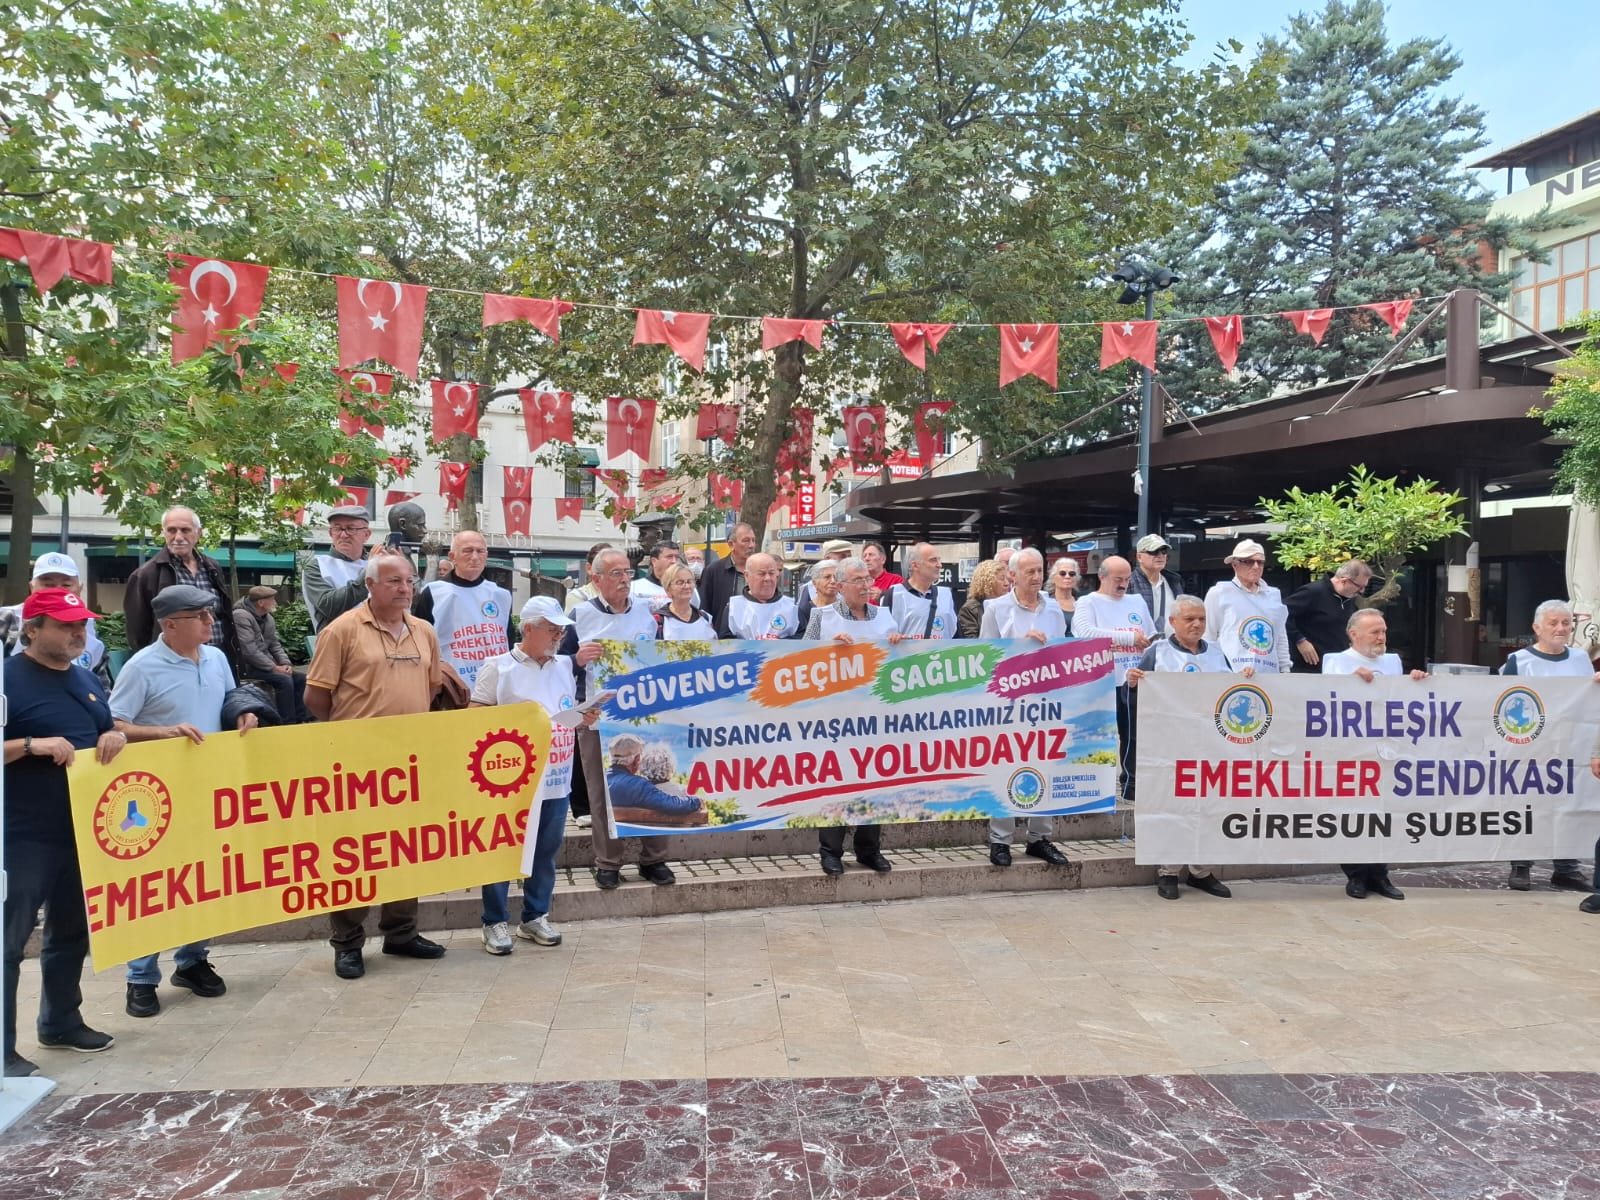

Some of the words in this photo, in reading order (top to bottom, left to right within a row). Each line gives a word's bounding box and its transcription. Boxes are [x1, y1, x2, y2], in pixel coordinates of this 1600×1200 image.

[802, 486, 813, 527] NOTE
[616, 661, 752, 710] GÜVENCE
[773, 652, 865, 694] GEÇİM
[890, 653, 987, 693] SAĞLIK
[998, 664, 1060, 692] SOSYAL
[1060, 649, 1114, 673] YAŞAM
[687, 723, 792, 748] İNSANCA
[797, 715, 877, 743] YAŞAM
[884, 705, 1015, 735] HAKLARIMIZ
[1019, 698, 1062, 727] İÇİN
[1305, 691, 1463, 745] BİRLEŞİK
[486, 753, 521, 771] DİSK
[686, 750, 843, 796] ANKARA
[850, 728, 1068, 780] YOLUNDAYIZ
[1174, 751, 1381, 797] EMEKLİLER
[1393, 750, 1574, 796] SENDİKASI
[213, 754, 420, 830] DEVRİMCİ
[1222, 808, 1392, 839] GİRESUN
[1405, 805, 1533, 843] ŞUBESİ
[86, 842, 320, 933] EMEKLİLER
[333, 810, 529, 876] SENDİKAS
[282, 875, 377, 914] ORDU
